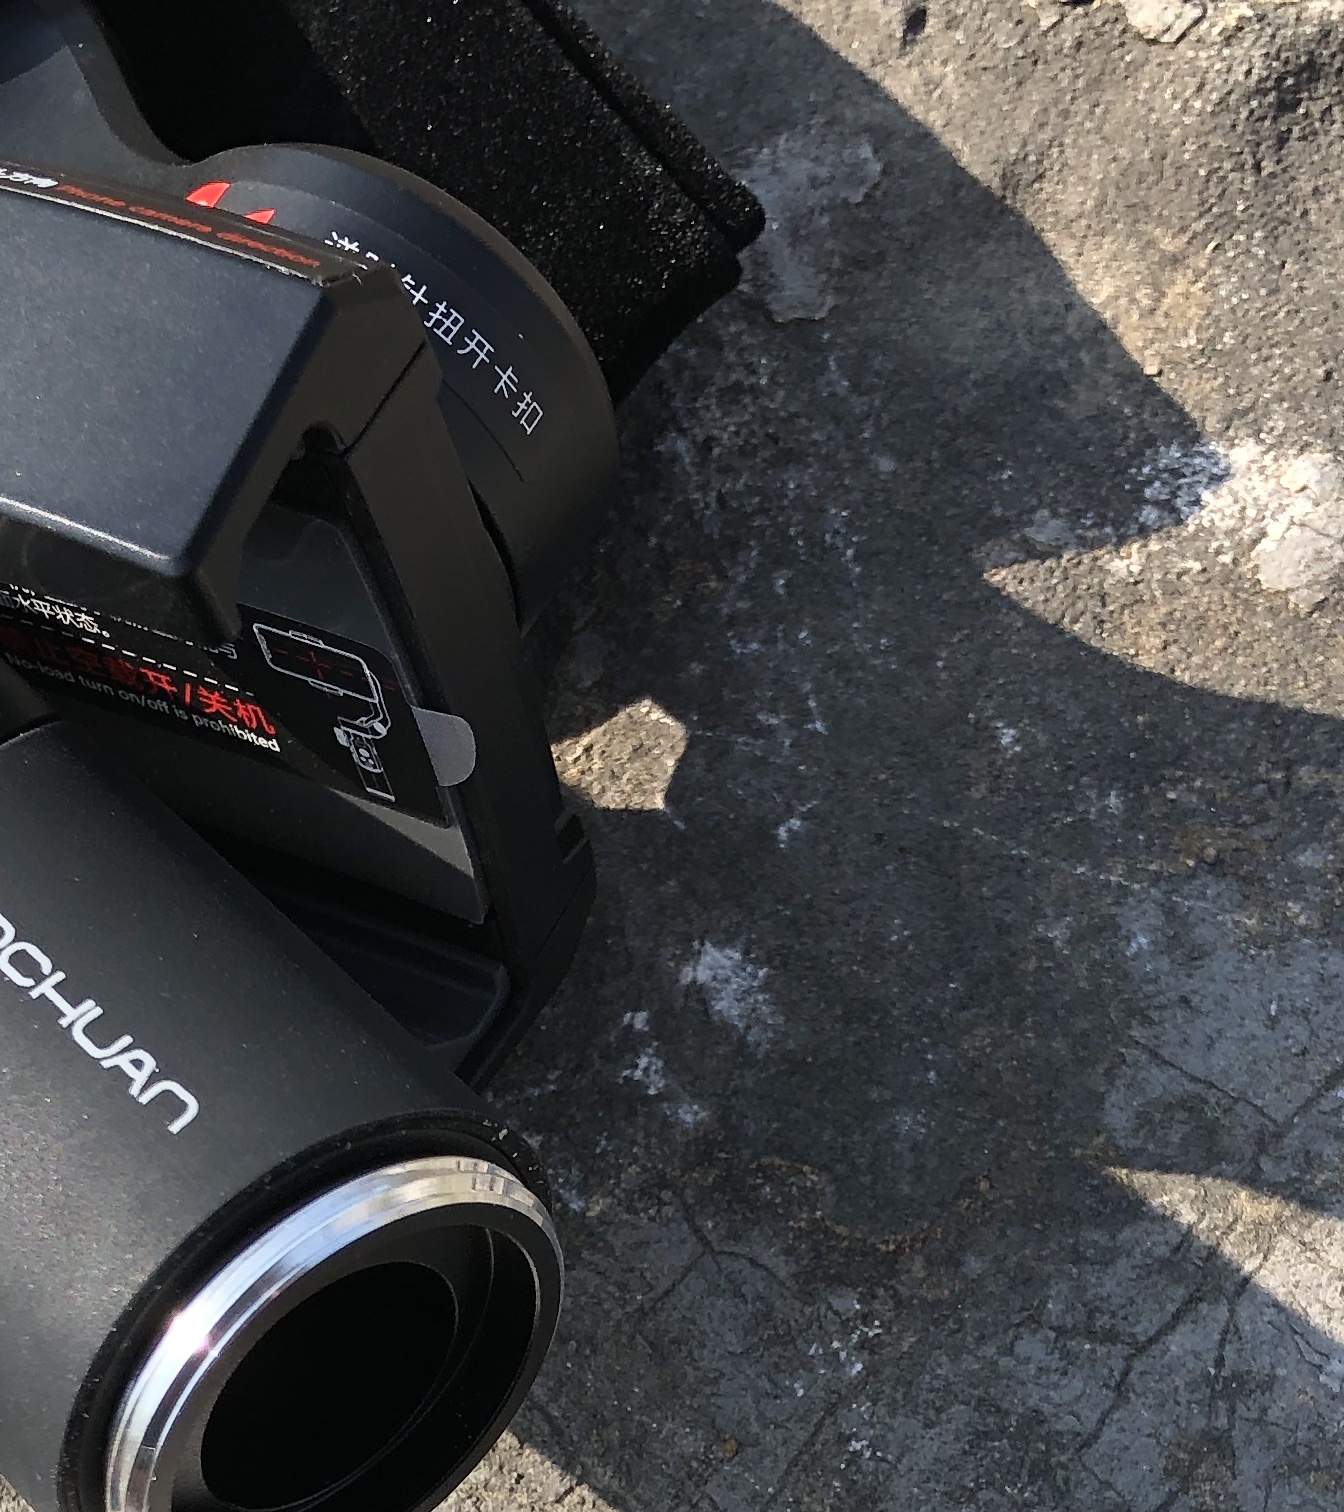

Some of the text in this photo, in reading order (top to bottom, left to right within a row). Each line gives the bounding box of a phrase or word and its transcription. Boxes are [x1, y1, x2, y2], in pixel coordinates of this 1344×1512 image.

[5, 652, 281, 752] No-load turn on/off is prohibited
